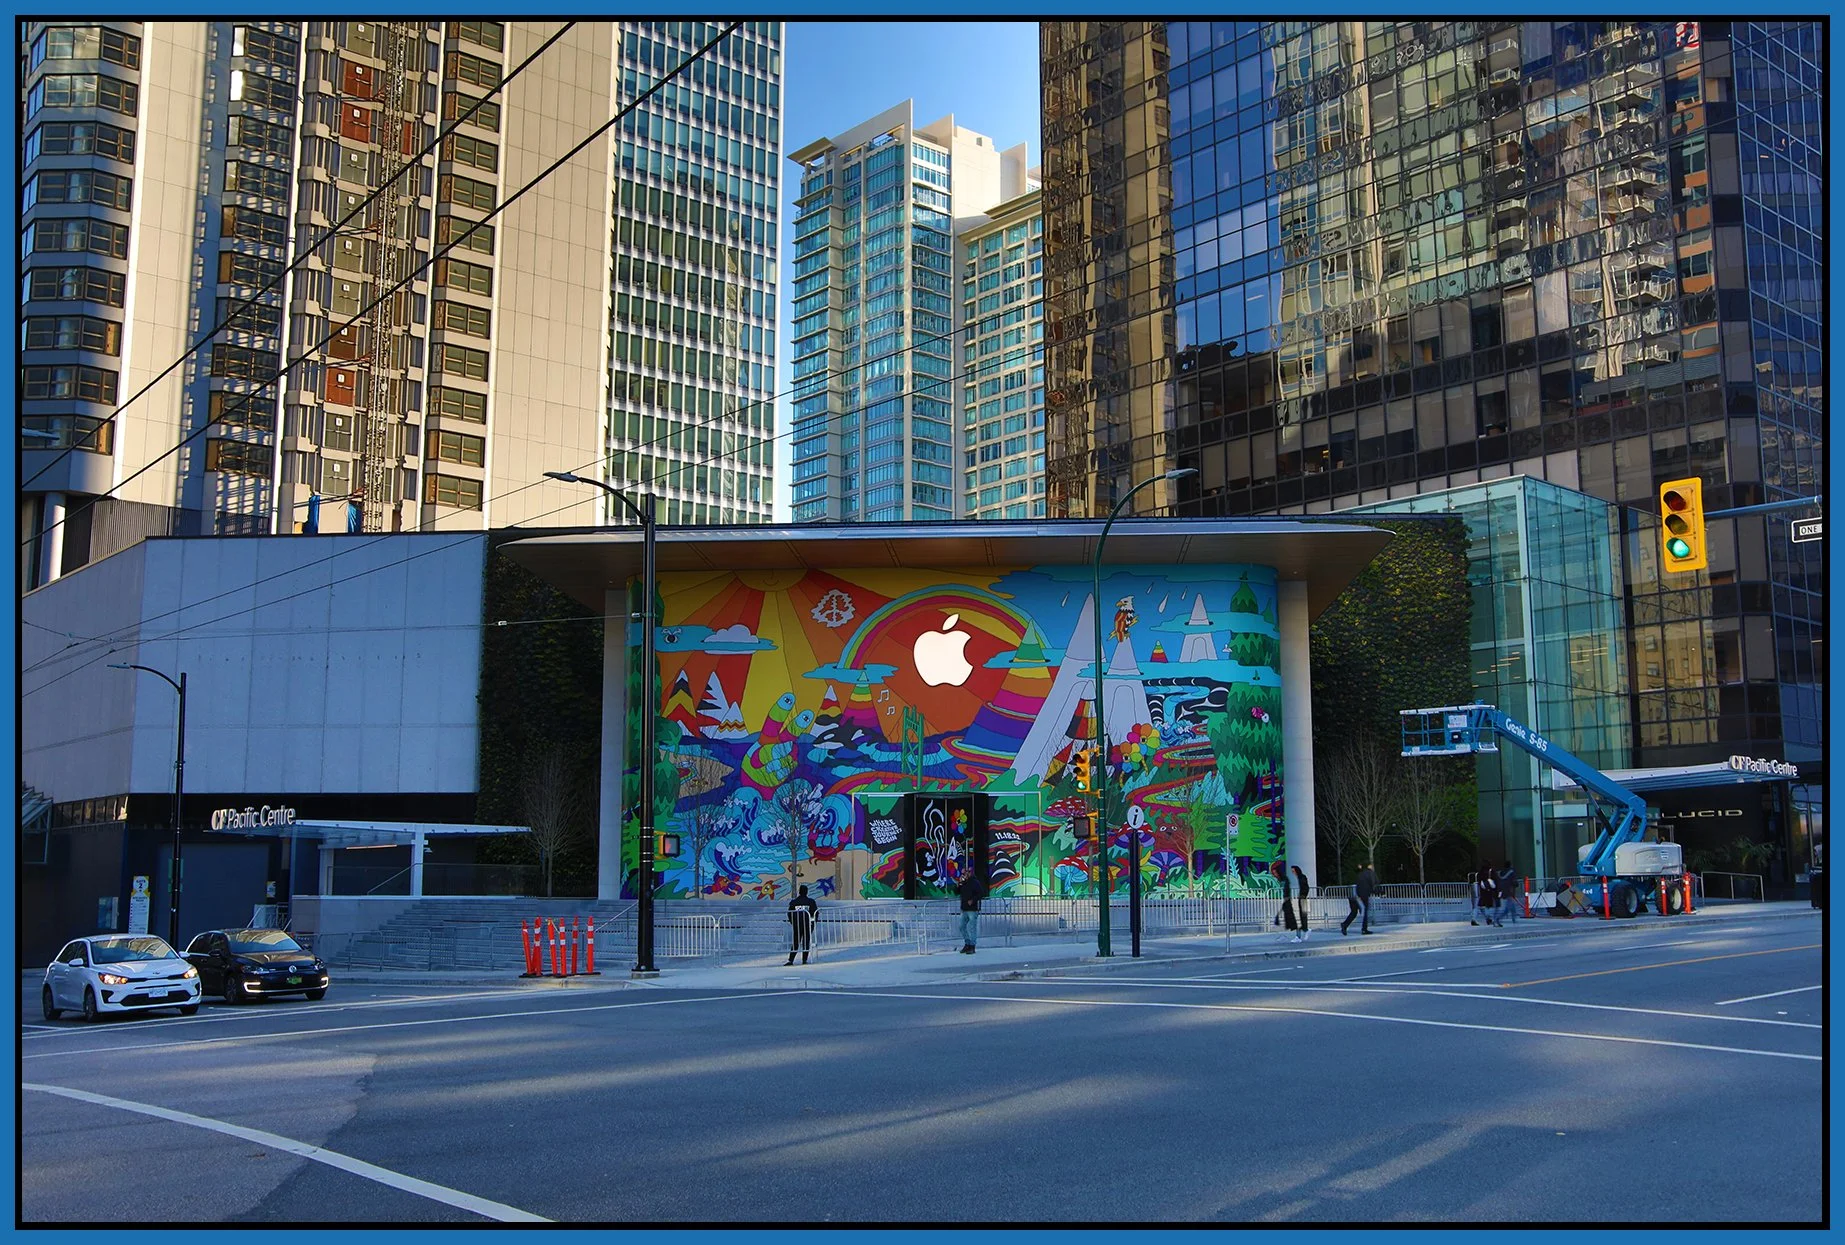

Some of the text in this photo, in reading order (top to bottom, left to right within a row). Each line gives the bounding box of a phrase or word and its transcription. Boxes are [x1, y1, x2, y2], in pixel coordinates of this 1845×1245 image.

[1801, 525, 1818, 534] ONE
[1505, 718, 1548, 752] Genie S-85
[1729, 755, 1798, 776] CF Pacific Centre
[211, 804, 296, 831] CF Pacific Centre
[1661, 809, 1743, 819] LUCID
[869, 819, 896, 828] WHERE
[874, 834, 897, 845] BEGIN
